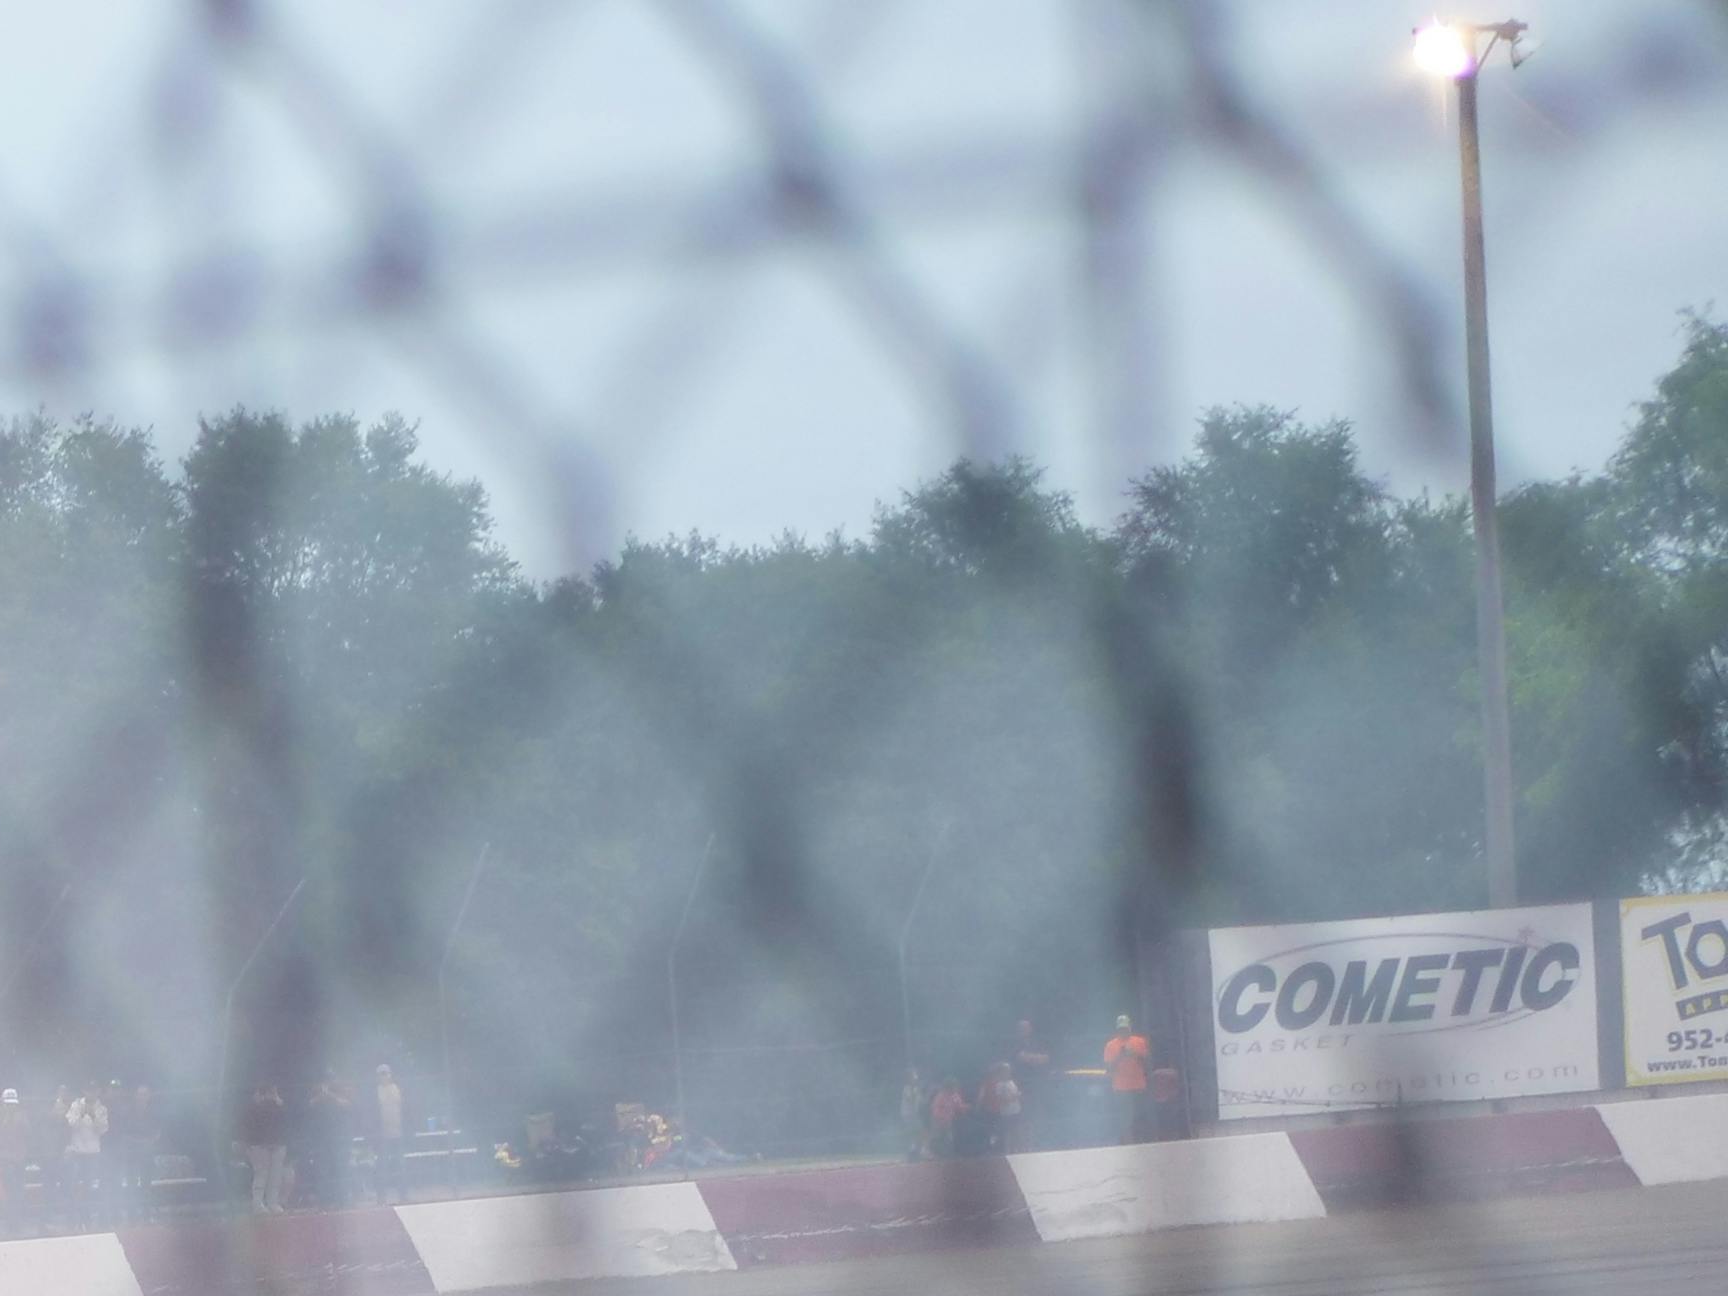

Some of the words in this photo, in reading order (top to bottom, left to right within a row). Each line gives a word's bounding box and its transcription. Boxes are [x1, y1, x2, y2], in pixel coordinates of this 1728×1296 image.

[1217, 941, 1581, 1034] COMETIC
[1220, 1035, 1353, 1057] GASKET
[1667, 1028, 1728, 1053] 952-
